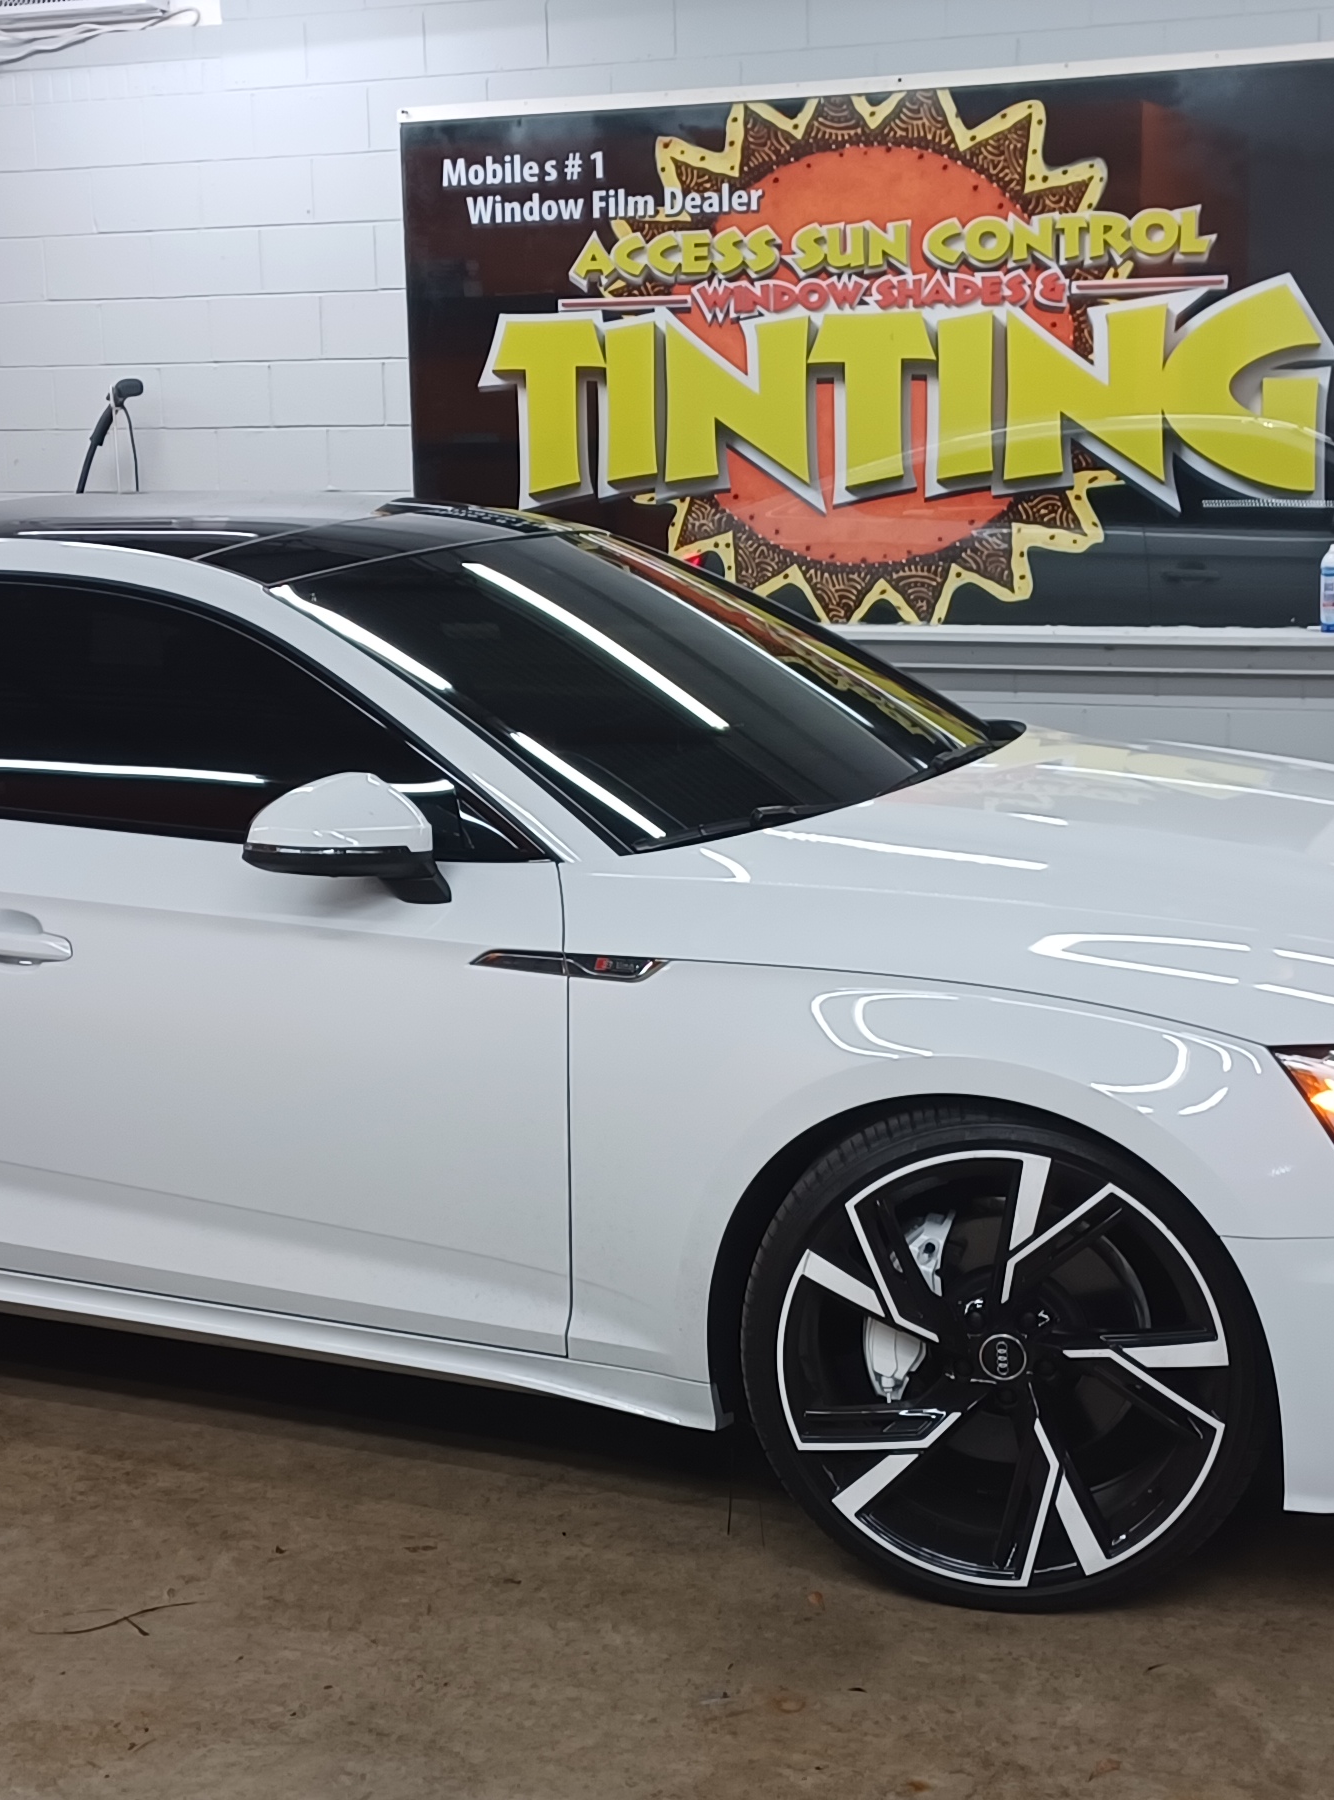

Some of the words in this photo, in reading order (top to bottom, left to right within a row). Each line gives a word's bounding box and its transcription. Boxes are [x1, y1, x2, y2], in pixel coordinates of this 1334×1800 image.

[564, 152, 582, 181] #
[590, 151, 605, 179] 1
[466, 192, 585, 225] Window
[592, 188, 656, 219] Film
[664, 183, 764, 216] Dealer
[569, 225, 782, 287] ACCESS
[791, 219, 910, 277] SUN
[923, 204, 1217, 268] CONTROL
[693, 276, 868, 315] WINDOW
[871, 271, 1030, 310] SHADES
[1033, 271, 1068, 306] &
